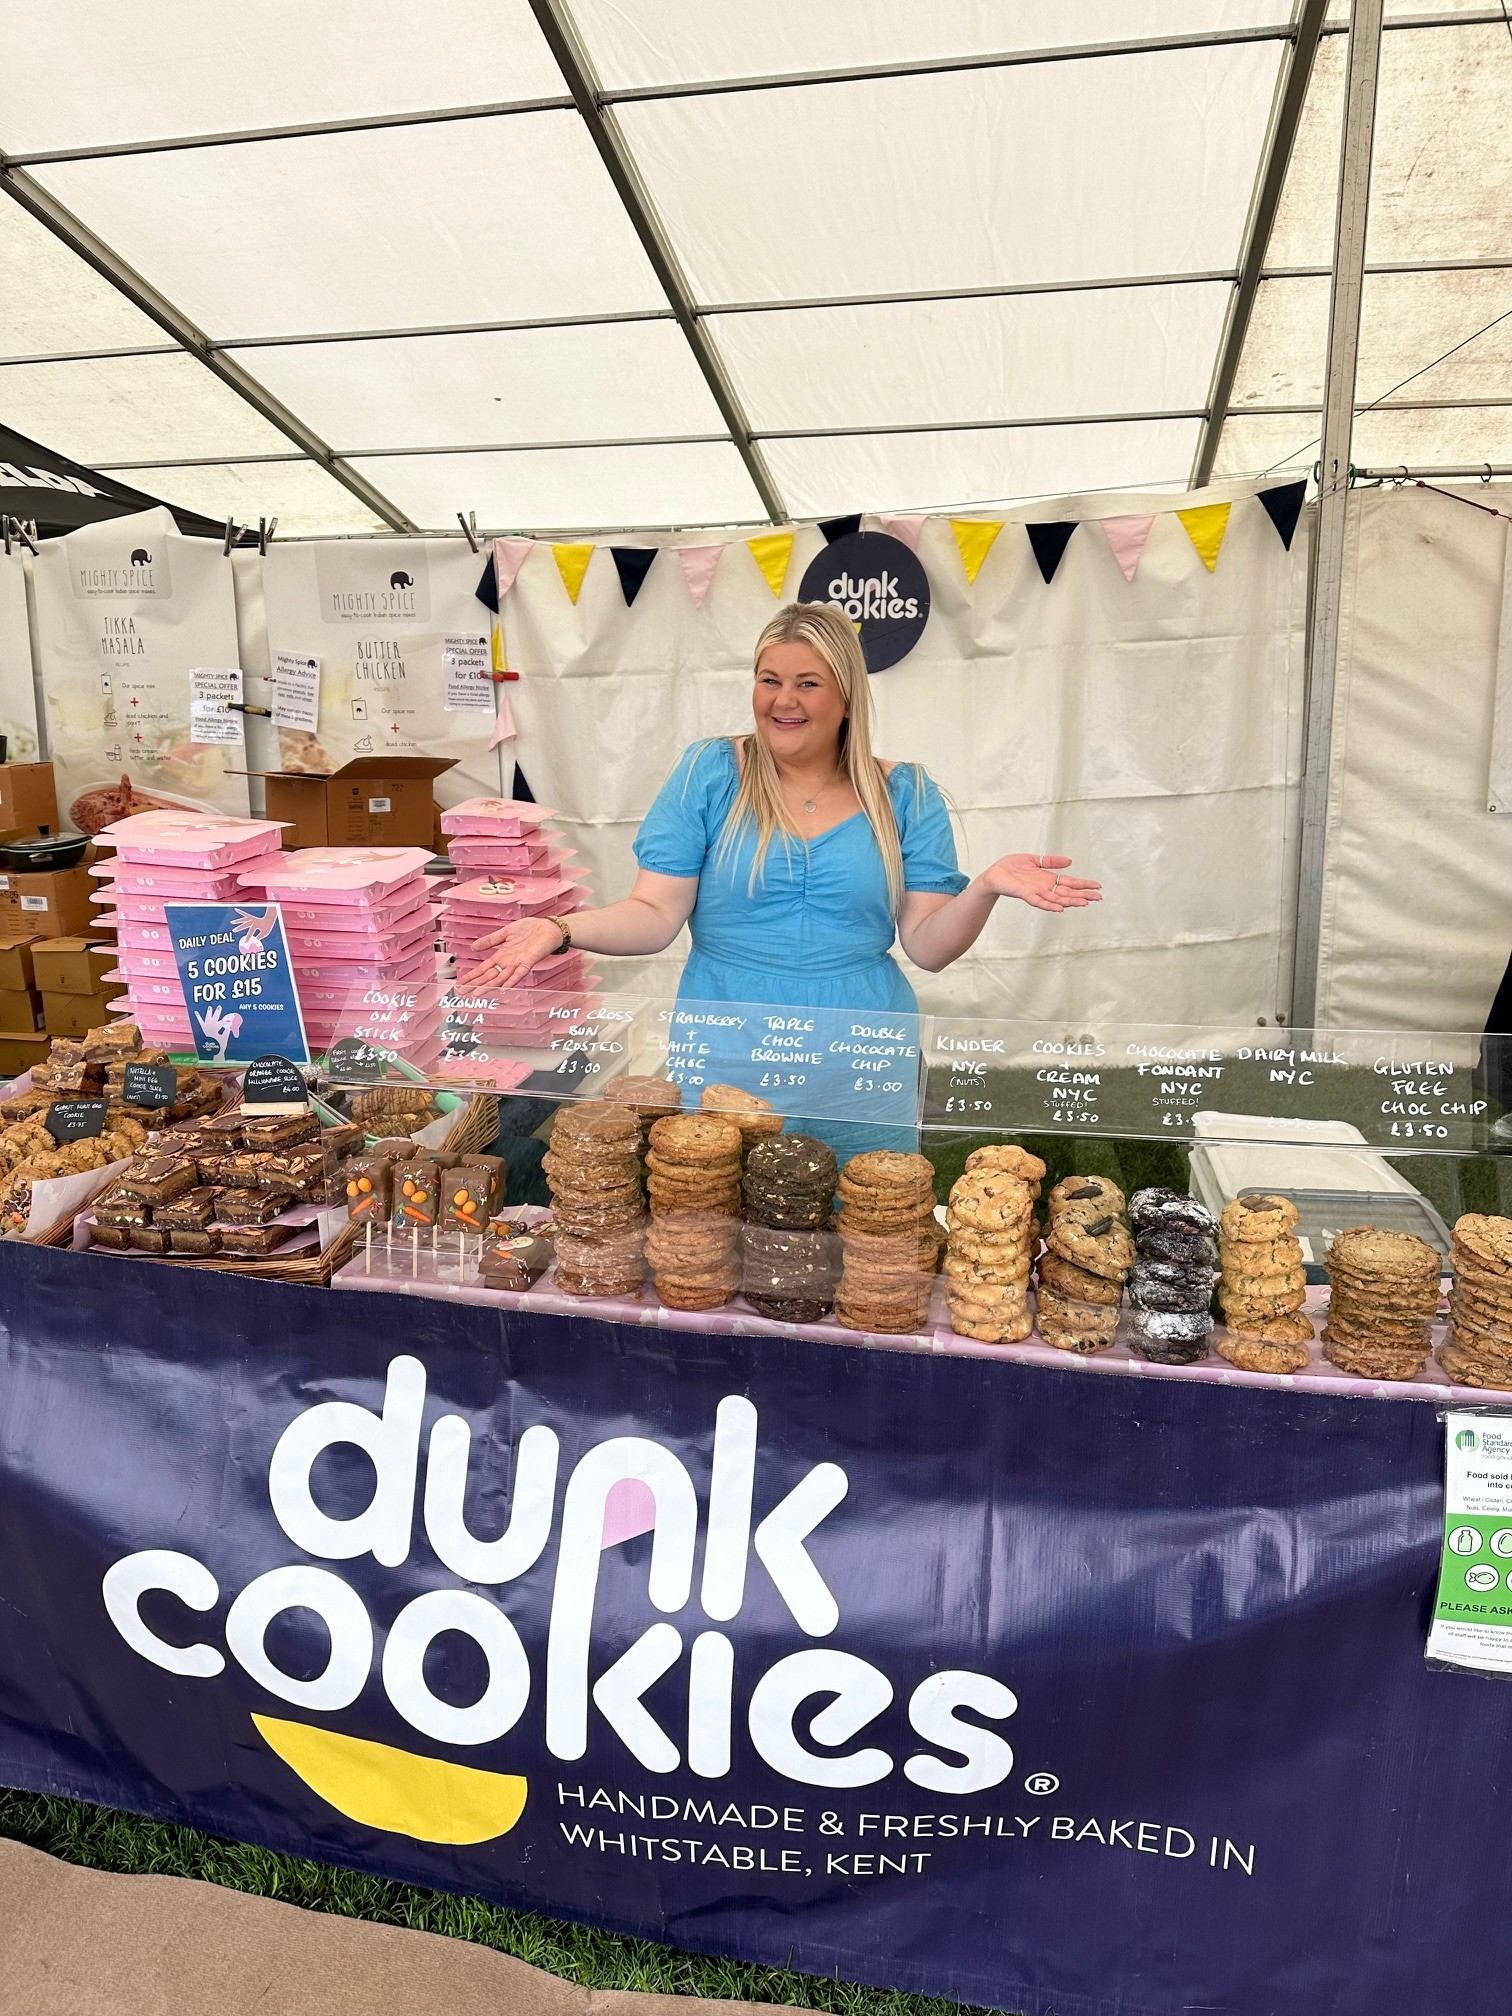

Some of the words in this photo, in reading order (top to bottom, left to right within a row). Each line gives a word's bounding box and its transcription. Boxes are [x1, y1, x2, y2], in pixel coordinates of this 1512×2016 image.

[80, 569, 118, 587] MIGHTY
[122, 569, 155, 587] SPICE
[828, 570, 899, 600] dunk
[332, 592, 375, 611] MIGHTY
[381, 592, 415, 610] SPICE
[808, 598, 919, 620] okies
[104, 616, 136, 634] TIKKA
[101, 636, 145, 655] MASALA
[357, 641, 401, 659] BUTTER
[277, 656, 294, 665] Mighty
[295, 658, 307, 666] Spice
[458, 658, 485, 667] packets
[277, 666, 296, 676] Allergy
[297, 669, 317, 678] Advice
[355, 661, 406, 680] CHICKEN
[455, 671, 467, 679] for
[194, 681, 218, 690] SPECIAL
[218, 682, 238, 691] OFFER
[199, 691, 204, 699] 3
[206, 692, 234, 701] packets
[178, 935, 207, 950] DAILY
[210, 931, 235, 946] DEAL
[187, 960, 199, 979] 5
[203, 950, 278, 978] COOKIES
[193, 981, 227, 1003] FOR
[231, 977, 263, 999] £15
[362, 989, 418, 1008] COOKIE
[239, 1003, 252, 1011] ANY
[548, 1006, 581, 1020] HOT
[586, 1008, 634, 1023] CROSS
[369, 1010, 392, 1023] ON
[397, 1010, 411, 1023] A
[445, 1012, 469, 1025] ON
[472, 1012, 485, 1025] A
[657, 1010, 747, 1030] STRAWBERRY
[762, 1015, 816, 1032] TRIPLE
[353, 1025, 404, 1042] STICK
[440, 1029, 484, 1044] STICK
[568, 1024, 600, 1037] BUN
[686, 1029, 698, 1041] +
[850, 1024, 907, 1041] DOUBLE
[549, 1038, 623, 1053] FROSTED
[657, 1040, 711, 1054] WHITE
[761, 1034, 804, 1048] CHOC
[936, 1035, 1006, 1054] KINDER
[1032, 1039, 1106, 1057] COOKIES
[750, 1048, 824, 1065] BROWNIE
[828, 1040, 918, 1058] CHOCOLATE
[1126, 1043, 1223, 1062] CHOCOLATE
[252, 1060, 284, 1069] CHOCOLATE
[665, 1056, 706, 1069] CHOC
[1237, 1047, 1296, 1067] DAIRY
[1300, 1049, 1348, 1066] MILK
[249, 1069, 273, 1077] ORANGE
[851, 1058, 892, 1073] CHIP
[951, 1060, 988, 1075] NYC
[1059, 1060, 1071, 1071] +
[1137, 1062, 1225, 1079] FONDANT
[1373, 1056, 1454, 1076] GLUTEN
[949, 1076, 986, 1089] (NUTS)
[1036, 1069, 1101, 1085] CREAM
[1269, 1069, 1315, 1086] NYC
[1052, 1087, 1098, 1102] NYC
[1160, 1081, 1203, 1096] NYC
[1391, 1079, 1449, 1096] FREE
[54, 1103, 75, 1112] GIANT
[1043, 1100, 1088, 1110] STUFFED!
[1152, 1097, 1199, 1108] STUFFED!
[1381, 1100, 1433, 1116] CHOC
[1440, 1100, 1489, 1116] CHIP
[63, 1111, 85, 1119] COOKIE
[1482, 1432, 1502, 1440] Food
[1481, 1445, 1511, 1455] Agency
[1466, 1471, 1488, 1479] Food
[1487, 1481, 1504, 1489] into
[269, 1355, 849, 1638] dunk
[1440, 1601, 1488, 1613] PLEASE
[102, 1549, 1019, 1795] cookies
[557, 1783, 805, 1833] HANDMADE
[818, 1811, 845, 1837] &
[858, 1812, 1042, 1839] FRESHLY
[1050, 1816, 1197, 1859] BAKED
[1210, 1836, 1256, 1877] IN
[559, 1822, 813, 1877] WHITSTABLE,
[826, 1852, 932, 1876] KENT
